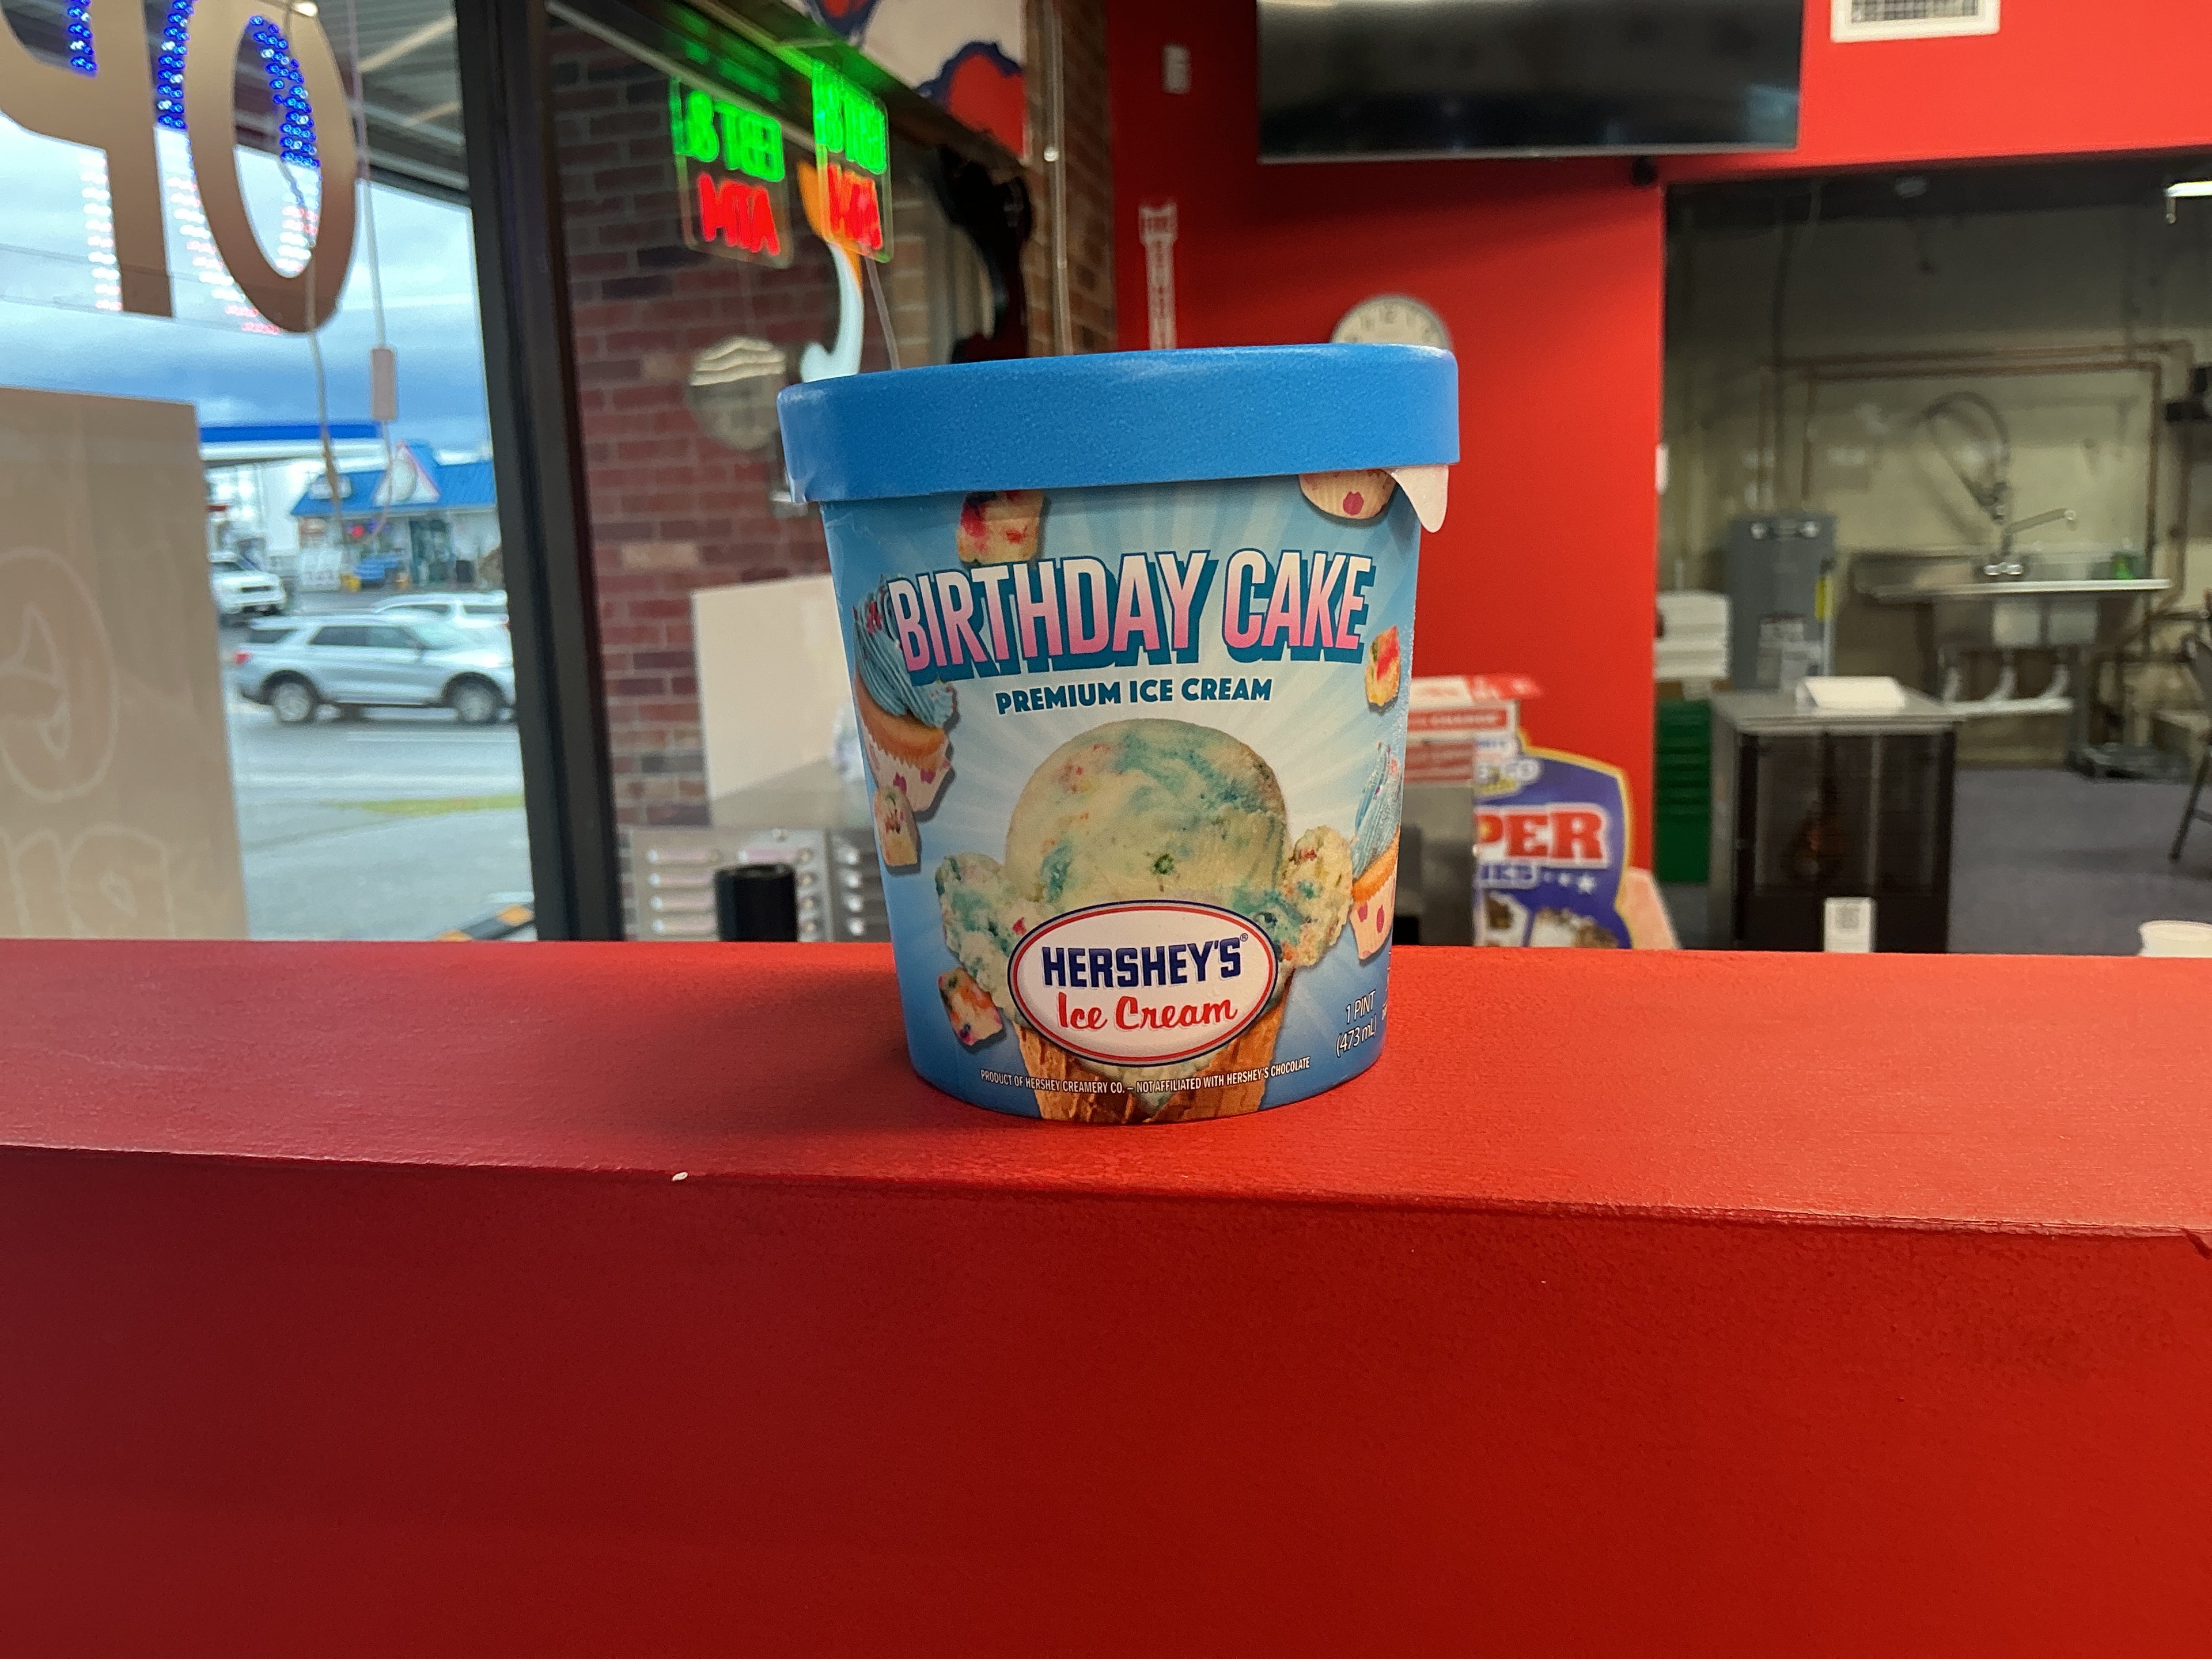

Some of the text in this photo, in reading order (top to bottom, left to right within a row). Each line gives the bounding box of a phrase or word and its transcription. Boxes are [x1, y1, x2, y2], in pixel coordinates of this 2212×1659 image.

[888, 548, 1374, 683] BIRTHDAY CAKE
[995, 679, 1271, 714] PREMIUM ICE CREAM
[1042, 937, 1242, 988] HERSHEY'S
[1058, 991, 1238, 1030] Ice Cream
[1346, 989, 1376, 1024] 1 PINT
[980, 1069, 1012, 1086] PRODUCT
[1014, 1076, 1024, 1087] OF
[1025, 1077, 1060, 1092] HERSHEY
[1063, 1081, 1109, 1093] CREAMERY
[1110, 1082, 1125, 1094] CO.
[1136, 1081, 1153, 1093] NOT
[1154, 1077, 1202, 1093] AFFILIATED
[1203, 1074, 1225, 1089] WITH
[1226, 1067, 1269, 1086] HERSHEY'S
[1270, 1056, 1311, 1078] CHOCOLATE
